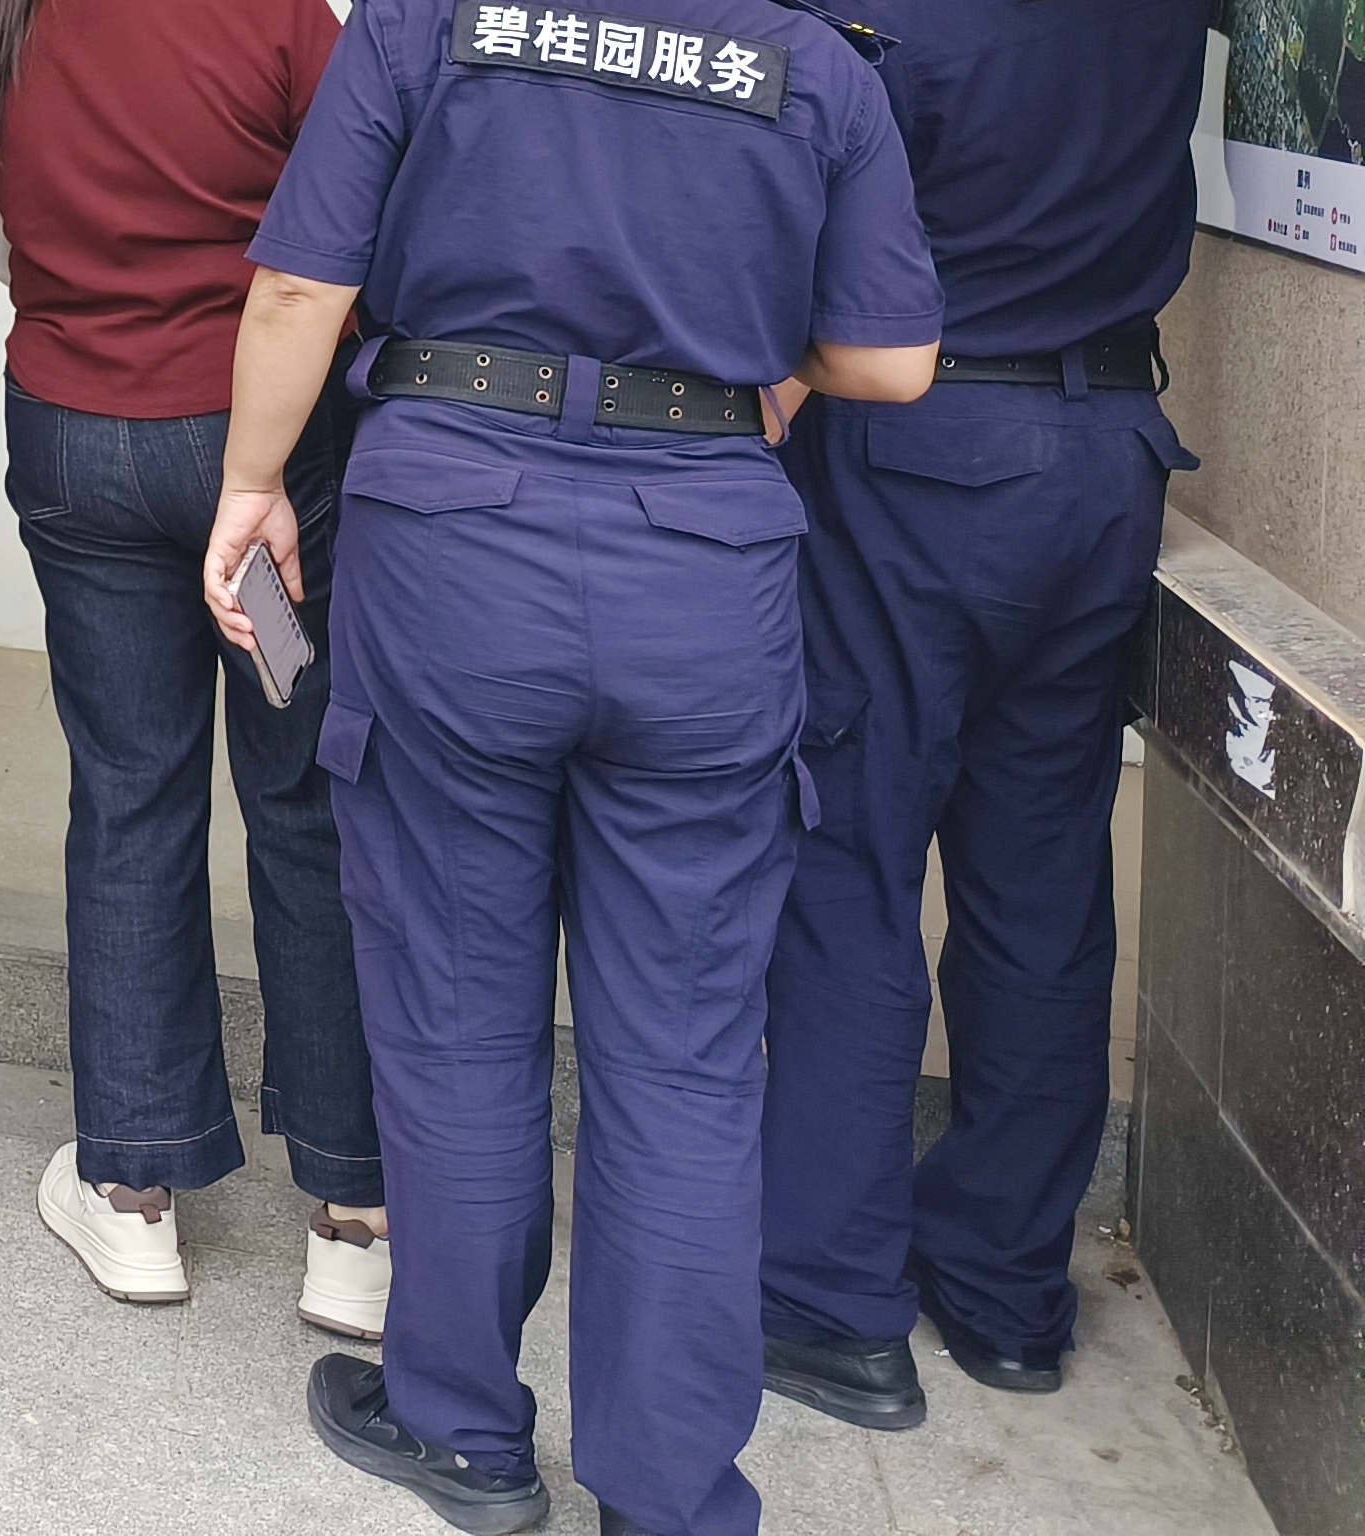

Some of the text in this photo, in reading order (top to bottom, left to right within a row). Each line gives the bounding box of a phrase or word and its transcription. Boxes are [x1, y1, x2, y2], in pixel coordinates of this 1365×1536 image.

[472, 5, 766, 101] 碧桂园服务
